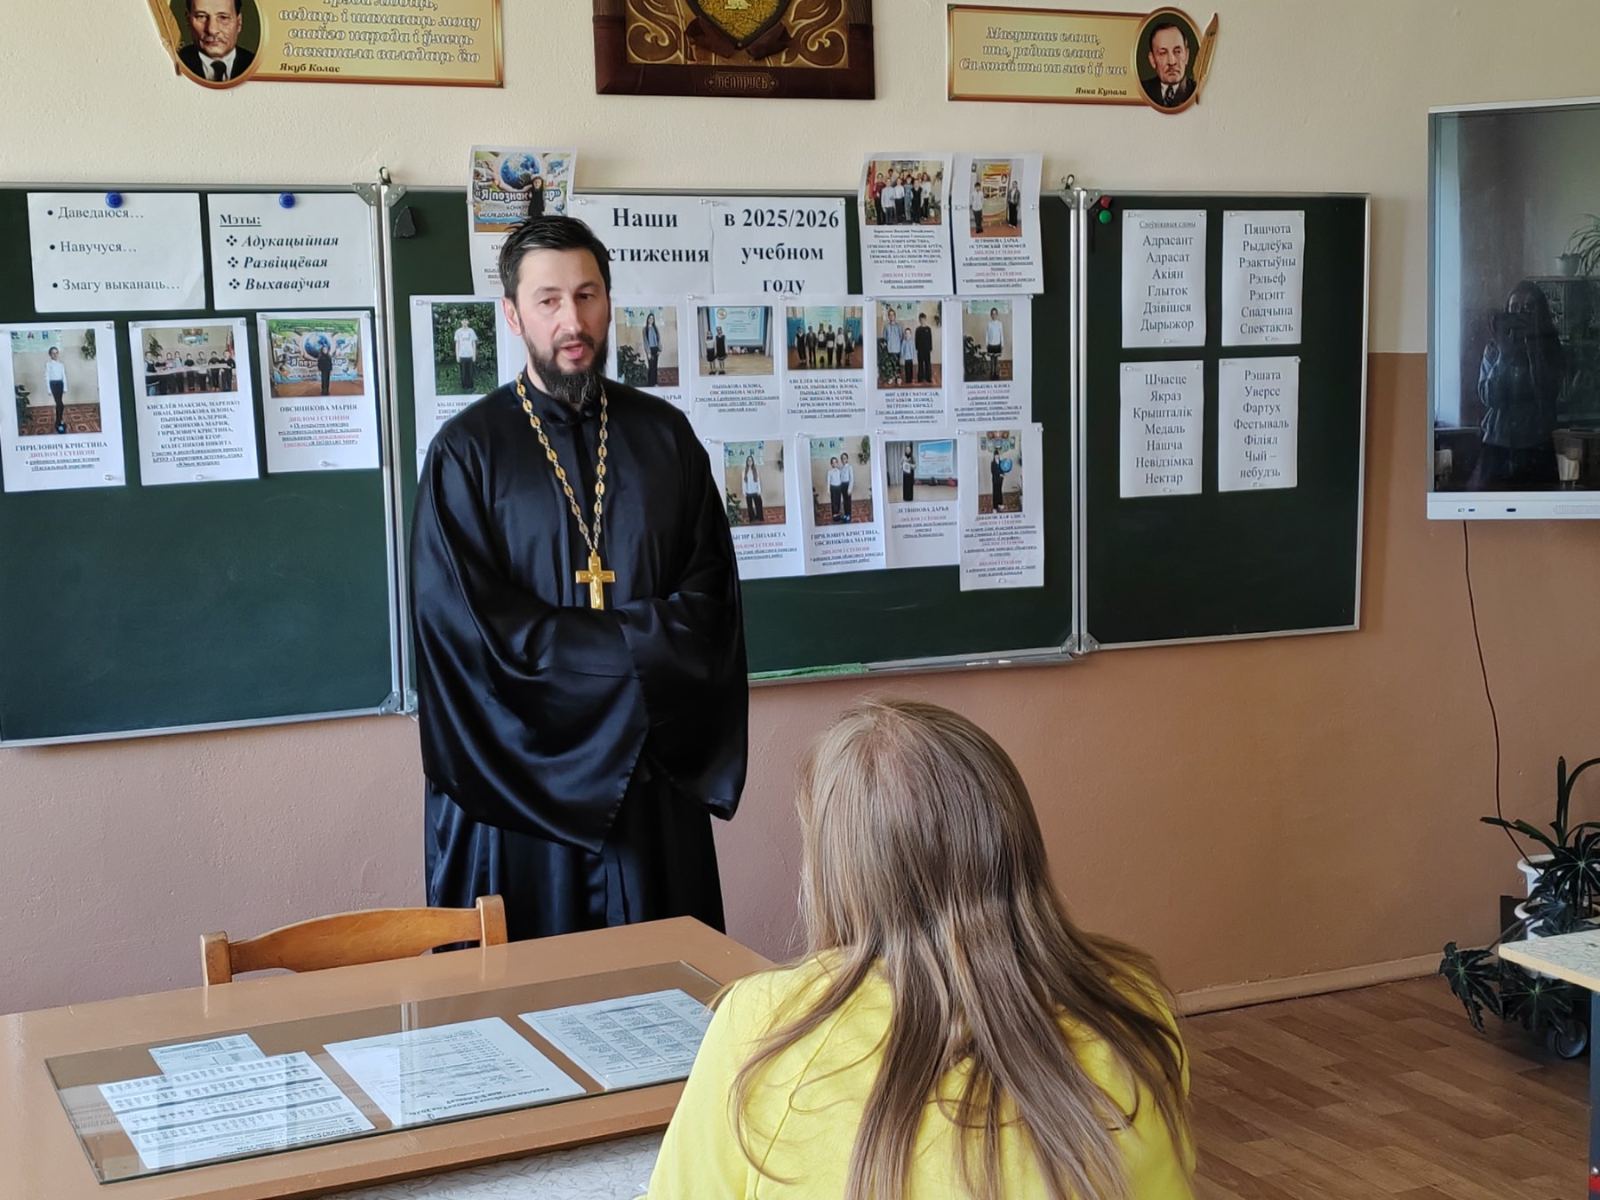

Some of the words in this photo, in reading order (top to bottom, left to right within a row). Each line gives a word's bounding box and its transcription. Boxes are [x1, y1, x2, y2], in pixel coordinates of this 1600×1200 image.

[280, 63, 306, 73] Якуб
[309, 63, 340, 73] Колас
[220, 214, 262, 227] Мэты:
[613, 207, 678, 228] Наши
[724, 213, 736, 227] в
[742, 208, 840, 229] 2025/2026
[1244, 223, 1292, 235] Пяшчота
[242, 234, 339, 249] Адукацыйная
[1142, 235, 1194, 248] Адрасант
[1242, 240, 1293, 252] Рыдлеўка
[608, 248, 709, 263] стижения
[741, 243, 824, 264] учебном
[1146, 251, 1190, 265] Адрасат
[243, 255, 328, 271] Развіццёвая
[1239, 256, 1296, 270] Рэактыўны
[1152, 267, 1184, 279] Акіян
[1249, 272, 1286, 286] Рэльеф
[62, 279, 101, 294] Змагу
[245, 276, 330, 292] Выхаваўчая
[762, 280, 806, 295] году
[1148, 286, 1188, 297] Глыток
[1250, 289, 1285, 301] Рэцэпт
[1241, 305, 1293, 319] Спадчына
[1140, 319, 1194, 333] Дырыжор
[1240, 322, 1294, 335] Спектакль
[1145, 373, 1187, 385] Шчасце
[1244, 369, 1281, 381] Рэшата
[1150, 390, 1182, 404] Якраз
[1244, 386, 1281, 398] Уверсе
[1133, 407, 1193, 422] Крышталік
[1243, 402, 1281, 415] Фартух
[1145, 424, 1186, 436] Медаль
[1233, 418, 1290, 430] Фестываль
[1146, 440, 1183, 452] Нашча
[1244, 434, 1278, 446] Філіял
[1245, 449, 1267, 462] Чый
[1136, 456, 1194, 469] Невідзімка
[1145, 472, 1183, 486] Нектар
[1240, 467, 1281, 479] небудзь
